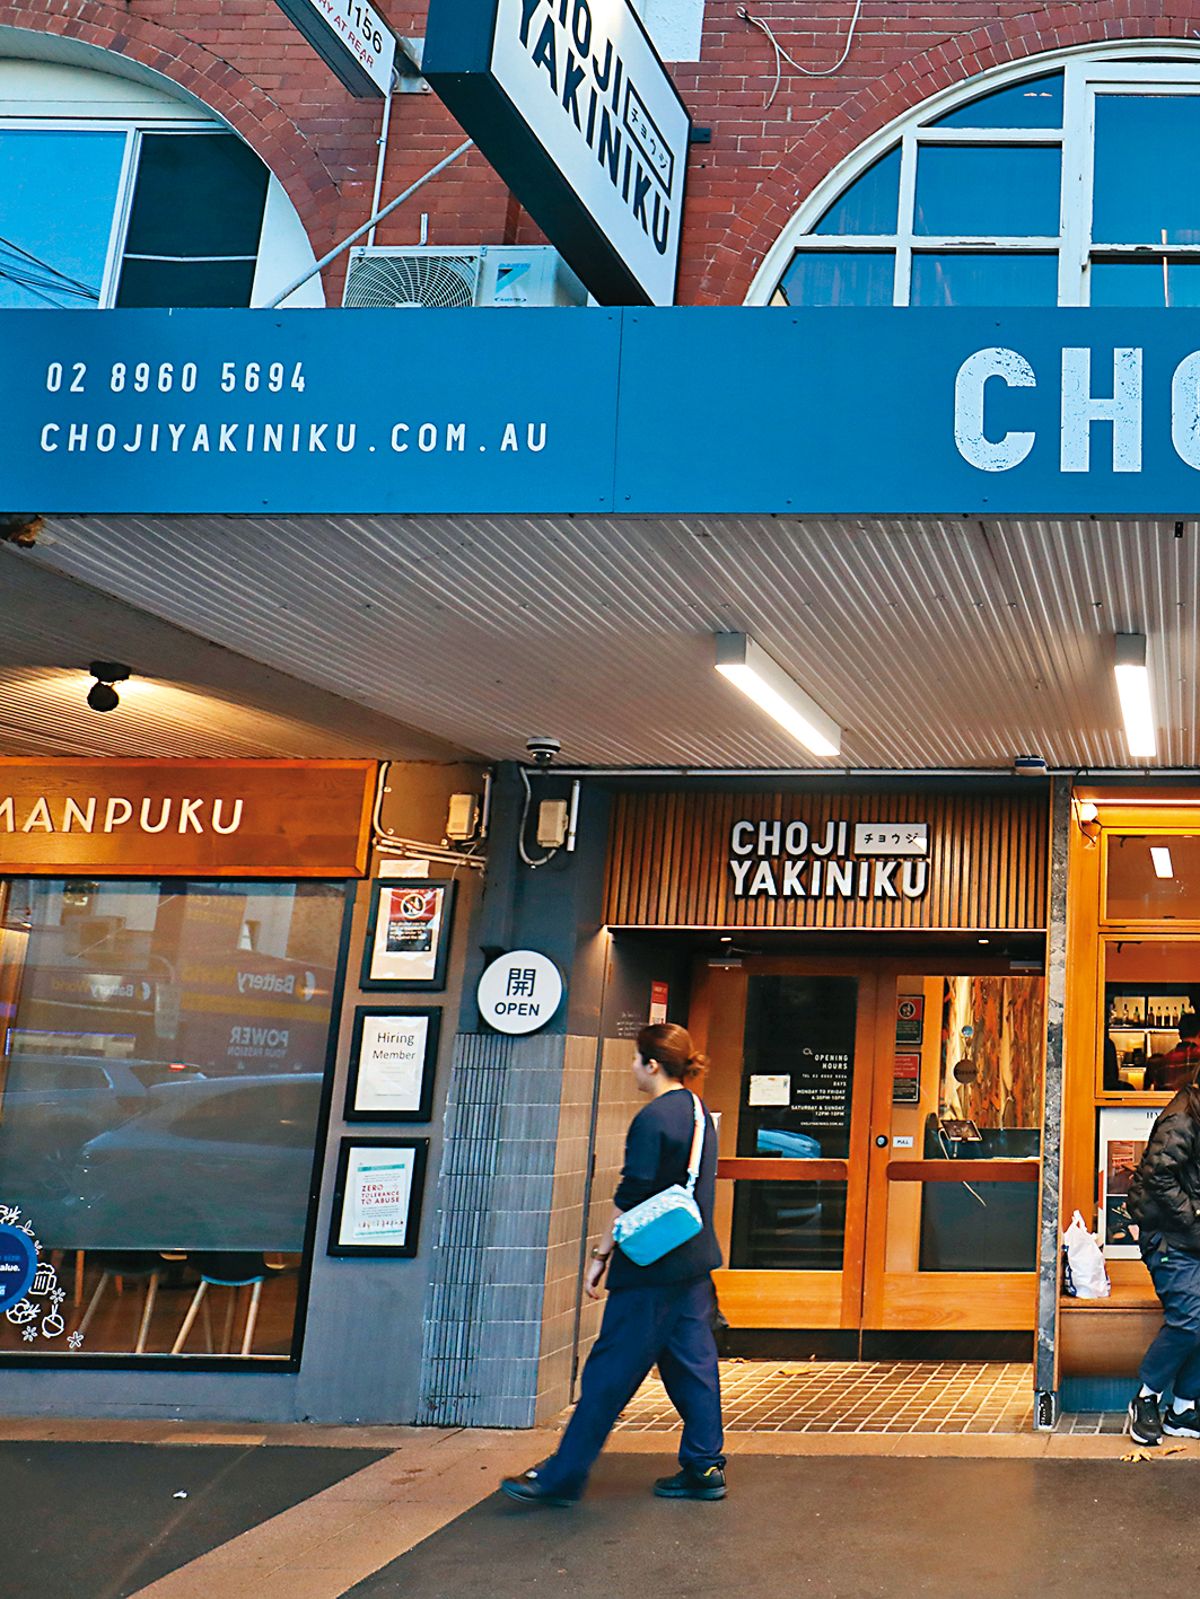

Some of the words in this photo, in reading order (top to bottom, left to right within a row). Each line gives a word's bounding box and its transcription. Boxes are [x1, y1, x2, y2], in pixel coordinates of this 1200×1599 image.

[333, 15, 348, 32] AT
[347, 31, 375, 69] REAR
[547, 0, 623, 117] OJI
[519, 0, 670, 256] YAKINIKU
[46, 361, 87, 394] 02
[109, 361, 198, 394] 8960
[220, 361, 308, 394] 5694
[39, 421, 550, 453] CHOJIYAKINIKU.COM.AU
[731, 820, 848, 857] CHOJI
[729, 860, 927, 898] YAKINIKU
[506, 967, 537, 997] 開
[494, 1001, 540, 1017] OPEN
[377, 1031, 416, 1047] Hiring
[372, 1049, 416, 1061] Member
[814, 1054, 849, 1062] OPENING
[822, 1062, 848, 1070] HOURS
[361, 1184, 384, 1193] ZERO
[361, 1190, 400, 1199] TOLERANCE
[361, 1198, 372, 1206] TO
[374, 1196, 400, 1205] ABUSE
[0, 1262, 21, 1272] alue.
